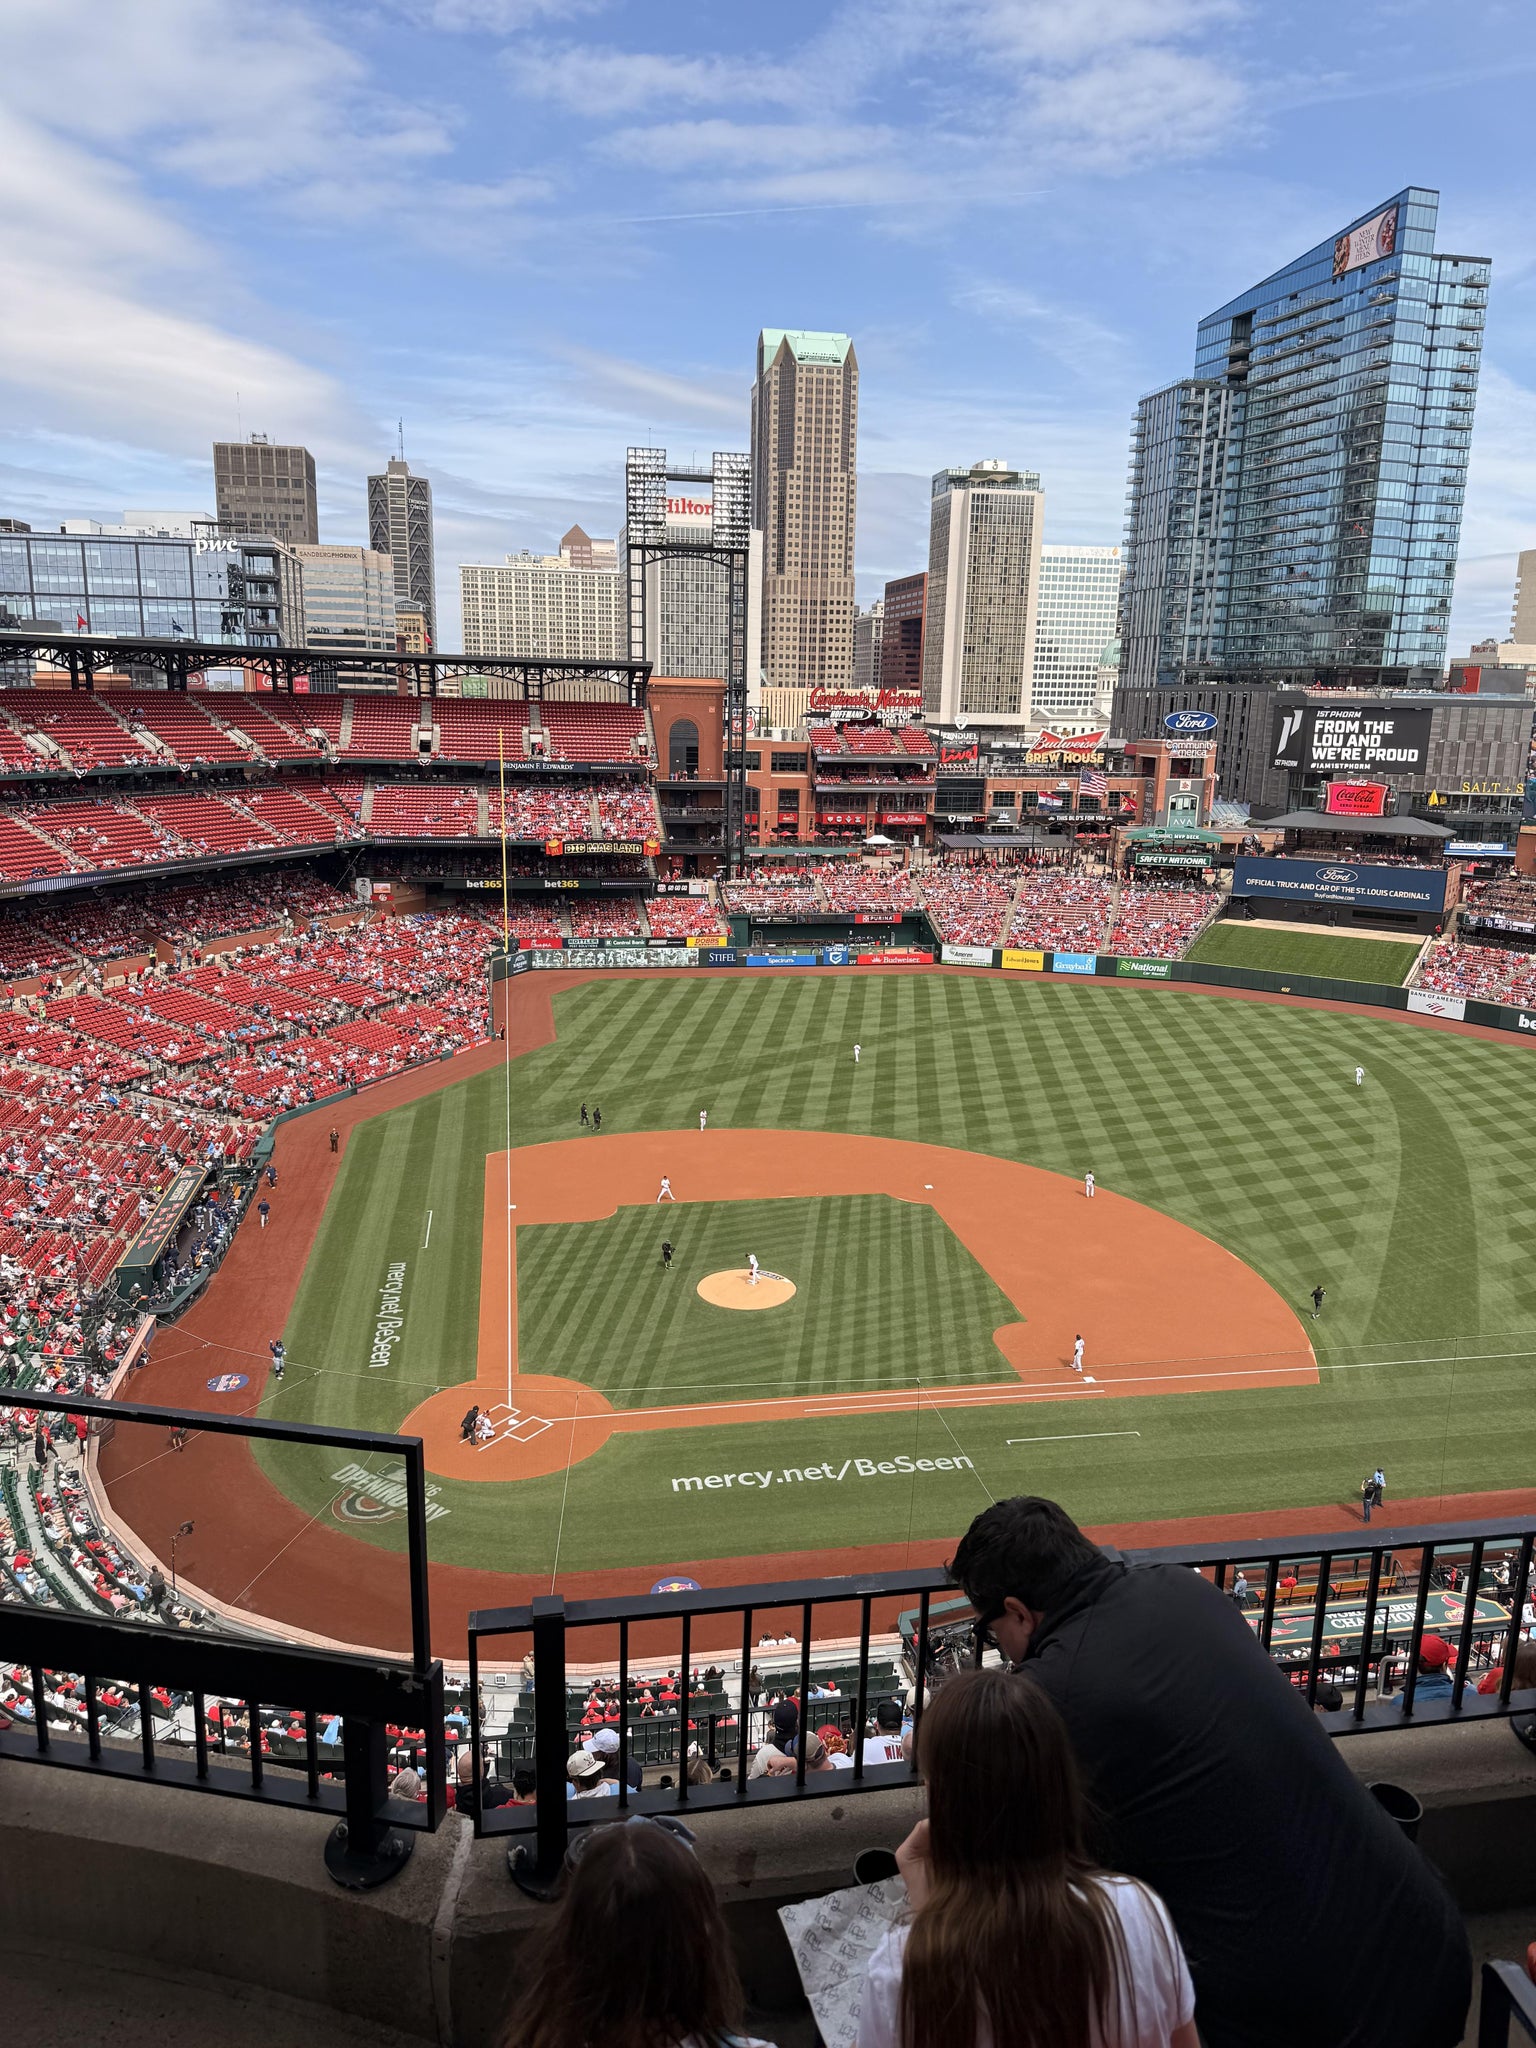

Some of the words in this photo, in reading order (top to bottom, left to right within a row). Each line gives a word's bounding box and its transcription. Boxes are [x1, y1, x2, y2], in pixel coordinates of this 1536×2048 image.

[195, 538, 238, 555] pwc
[810, 687, 871, 710] Cardinals
[870, 688, 923, 711] Nation
[830, 711, 865, 719] HOFFMANN
[1175, 713, 1208, 728] Ford
[1314, 720, 1360, 734] FROM
[1363, 721, 1394, 734] THE
[1166, 740, 1214, 751] Community
[1313, 734, 1344, 747] LOU
[1346, 735, 1381, 747] AND
[1025, 753, 1062, 764] BREW
[1063, 753, 1105, 764] HOUSE
[1311, 747, 1361, 761] WE'RE
[1365, 748, 1419, 762] PROUD
[503, 762, 534, 770] BENJAMIN
[1310, 762, 1371, 770] #IAM1STPHORM
[1462, 781, 1501, 793] SALT
[586, 843, 613, 853] MAC
[613, 843, 642, 854] LAND
[1140, 855, 1168, 863] SAFETY
[1168, 857, 1208, 865] NATIONAL
[1322, 869, 1351, 882] Ford
[466, 880, 502, 888] bet365
[544, 880, 580, 888] bet365
[1246, 878, 1276, 887] OFFICIAL
[1276, 880, 1299, 889] TRUCK
[1299, 882, 1315, 890] AND
[1315, 883, 1330, 891] CAR
[1341, 885, 1355, 893] THE
[1367, 888, 1388, 897] LOUIS
[1389, 890, 1431, 900] CARDINALS
[709, 953, 736, 962] STIFEL
[1130, 962, 1168, 973] National
[1410, 991, 1427, 999] BANK
[1436, 995, 1464, 1005] AMERICA
[368, 1262, 406, 1367] mercy.net/BeSeen
[671, 1455, 974, 1492] mercy.net/BeSeen
